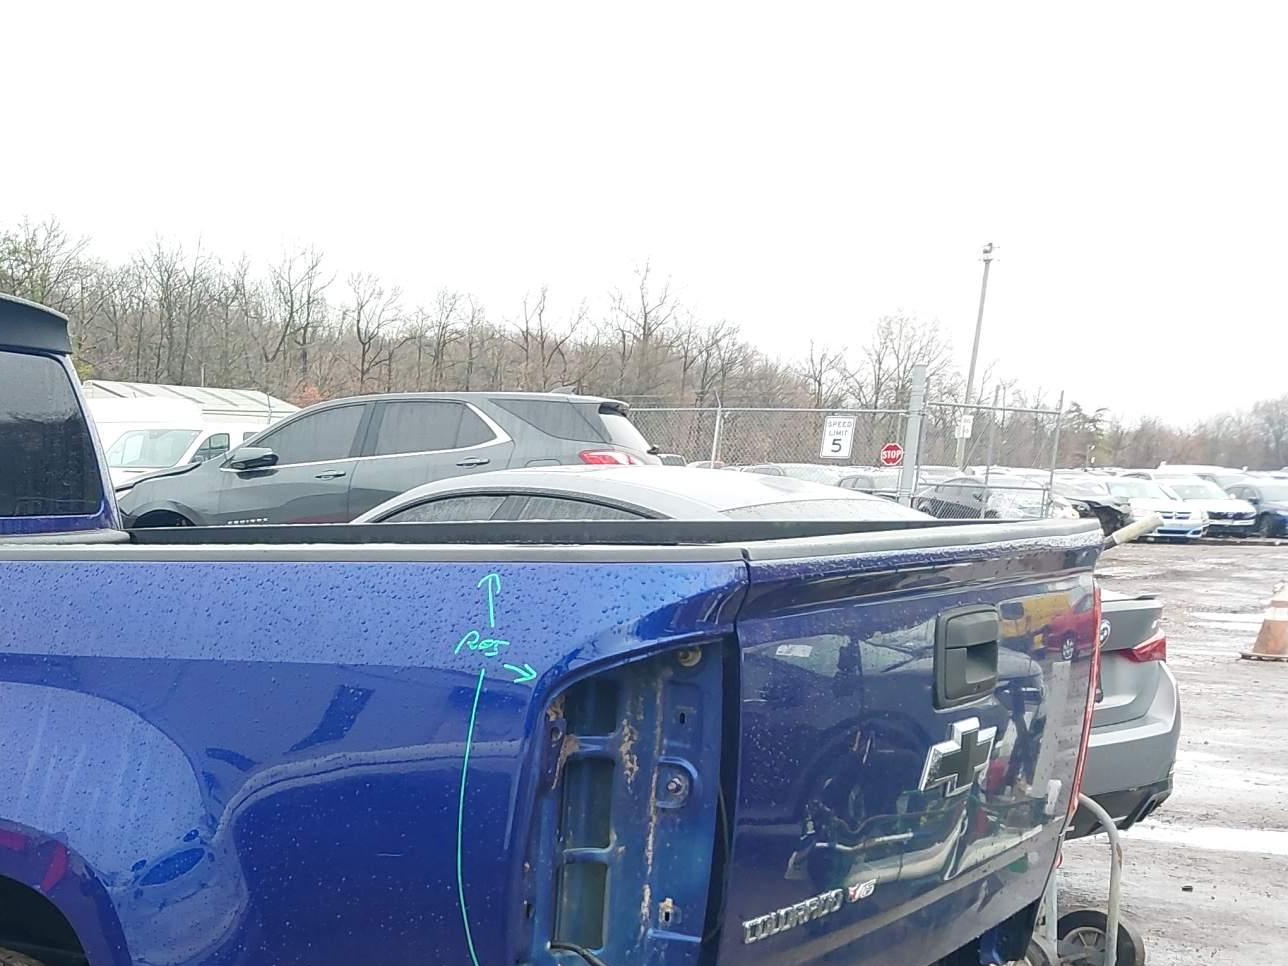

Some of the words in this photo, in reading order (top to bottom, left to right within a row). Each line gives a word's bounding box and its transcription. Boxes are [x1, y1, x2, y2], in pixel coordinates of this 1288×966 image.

[831, 438, 842, 453] 5
[883, 449, 902, 459] STOP
[742, 888, 844, 945] COLORADO
